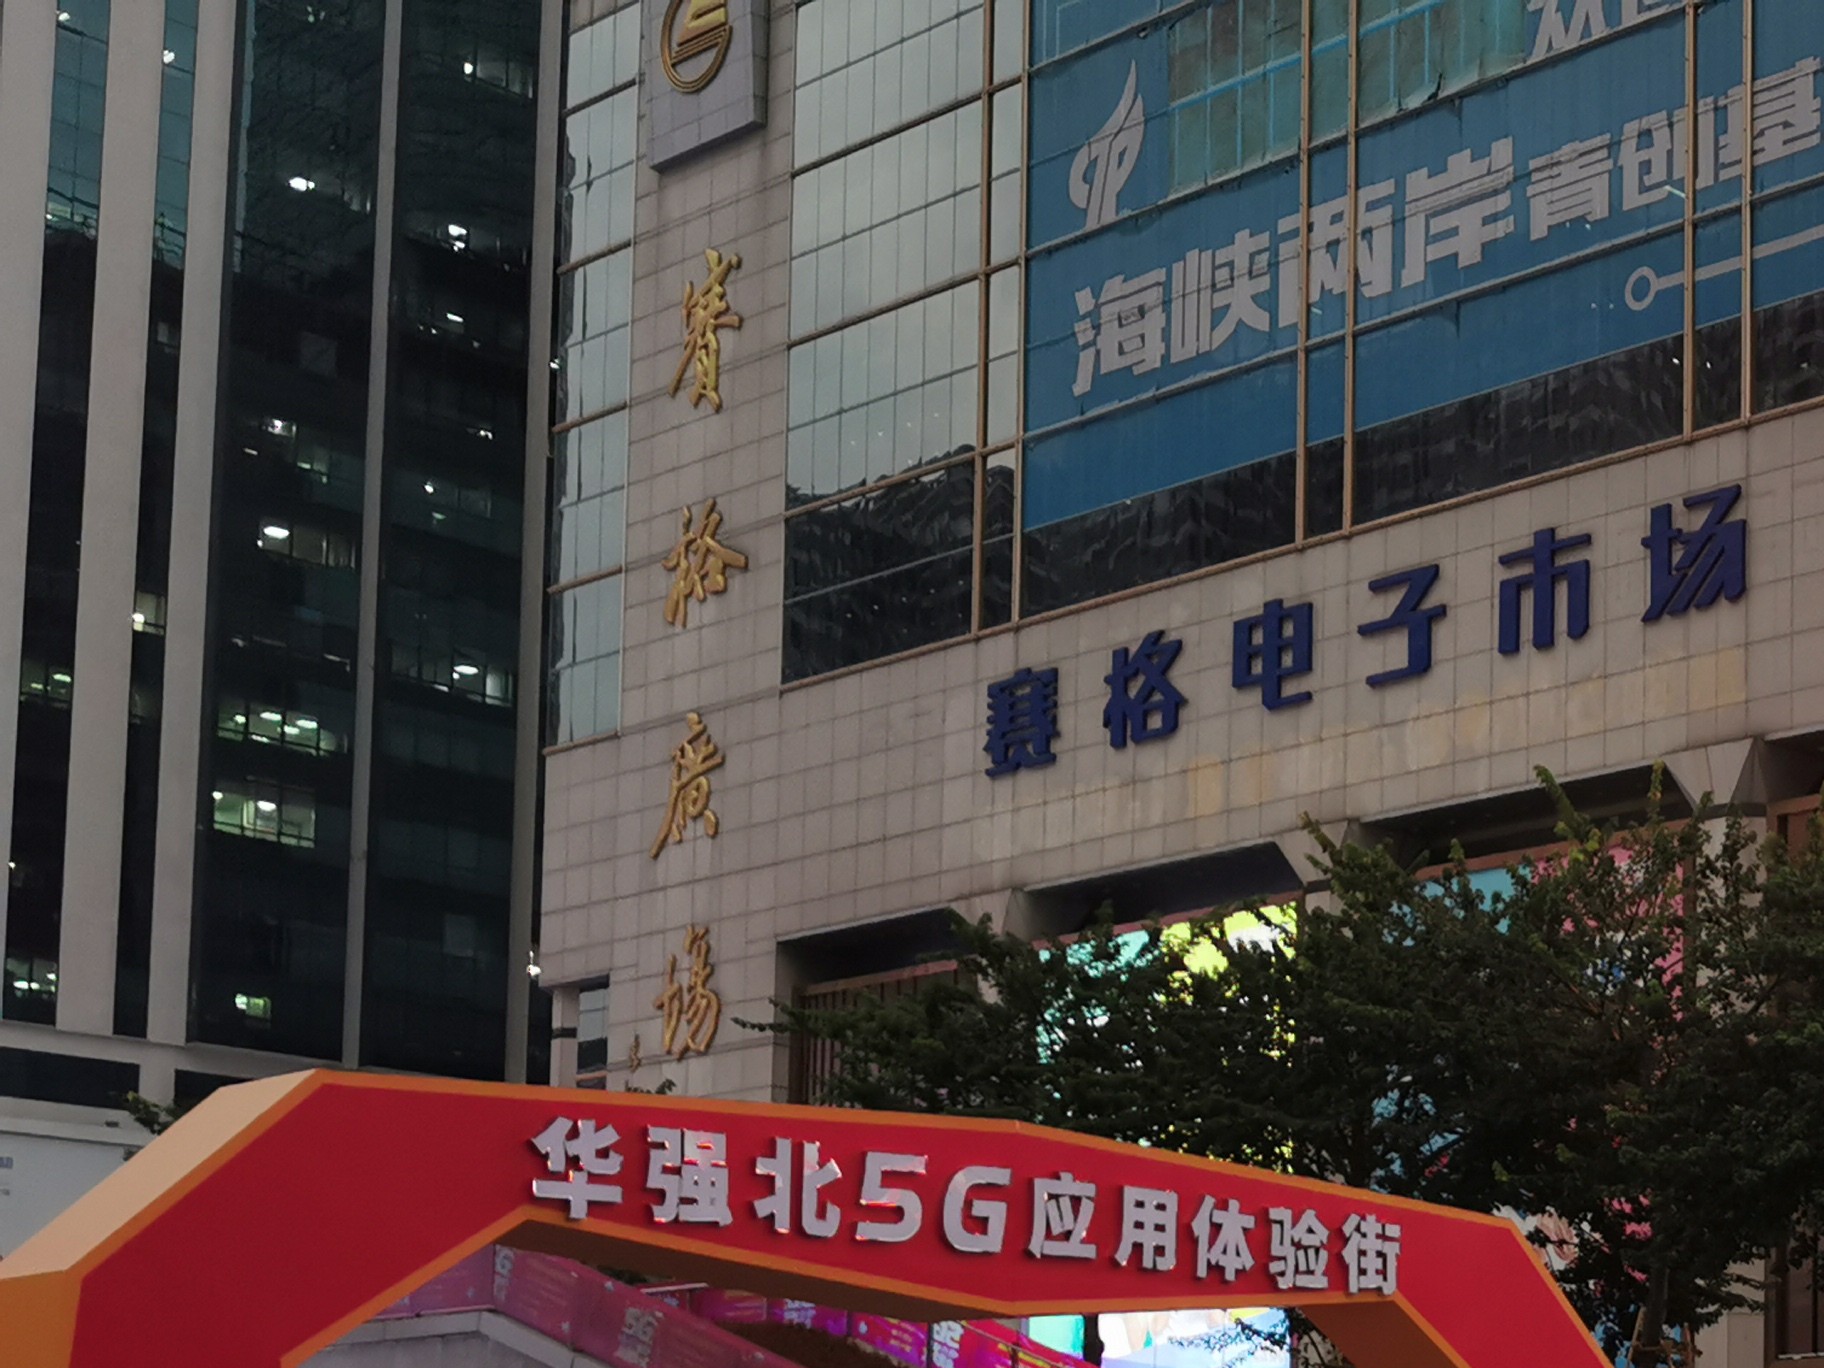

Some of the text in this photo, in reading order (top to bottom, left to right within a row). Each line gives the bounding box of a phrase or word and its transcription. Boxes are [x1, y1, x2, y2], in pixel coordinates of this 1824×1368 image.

[984, 484, 1747, 777] 赛格电子市场
[532, 1117, 1403, 1295] 华强北5G应用体验街
